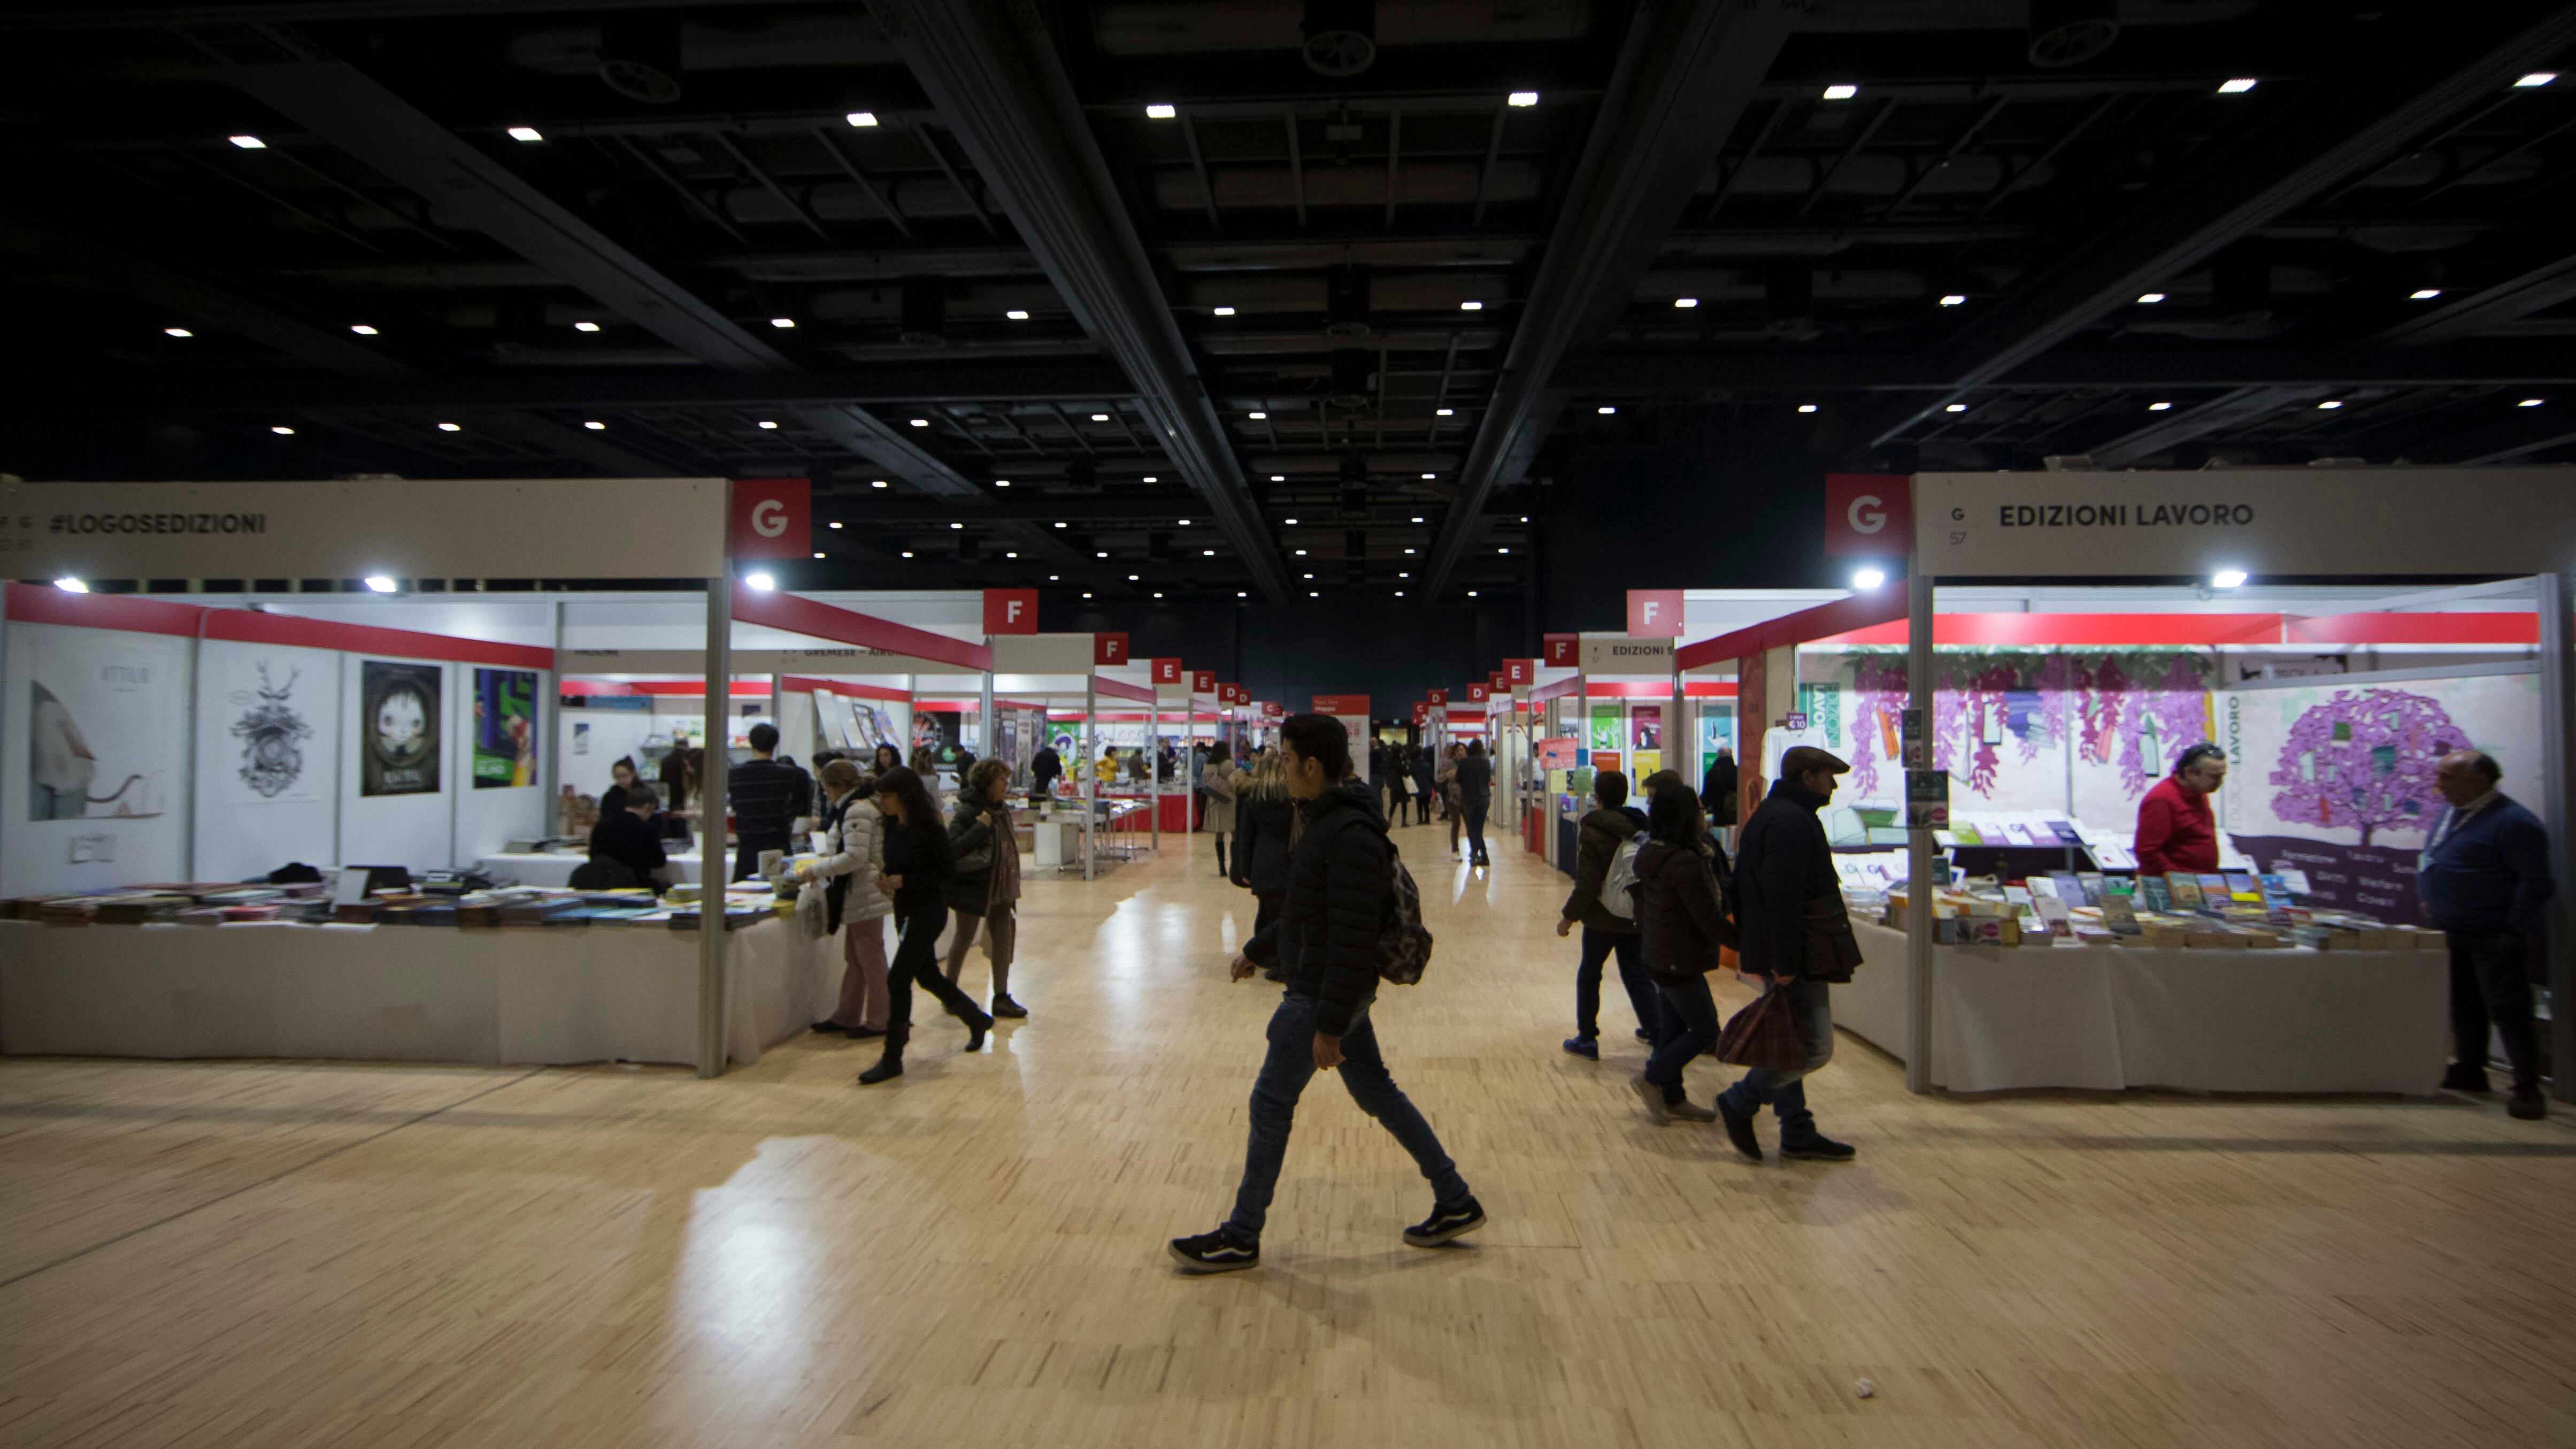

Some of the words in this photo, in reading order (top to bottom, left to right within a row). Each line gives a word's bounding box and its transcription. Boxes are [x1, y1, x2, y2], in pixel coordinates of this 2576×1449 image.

[752, 499, 788, 538] G
[1848, 495, 1887, 534] G
[1951, 508, 1965, 521] G
[1999, 505, 2127, 527] EDIZIONI
[2136, 504, 2254, 526] LAVORO
[50, 514, 266, 534] #LOGOSEDIZIONI
[1007, 600, 1022, 624] F
[1643, 602, 1659, 625] F
[1106, 640, 1118, 658] F
[1556, 643, 1566, 660] F
[1612, 646, 1664, 656] EDIZIONI
[1164, 664, 1173, 678] E
[1511, 665, 1520, 679] E
[1199, 676, 1208, 688] E
[1496, 677, 1504, 689] E
[1227, 687, 1236, 697] D
[1240, 693, 1248, 702] D
[1432, 694, 1440, 703] D
[1473, 688, 1482, 698] D
[2228, 696, 2241, 765] LAVORO
